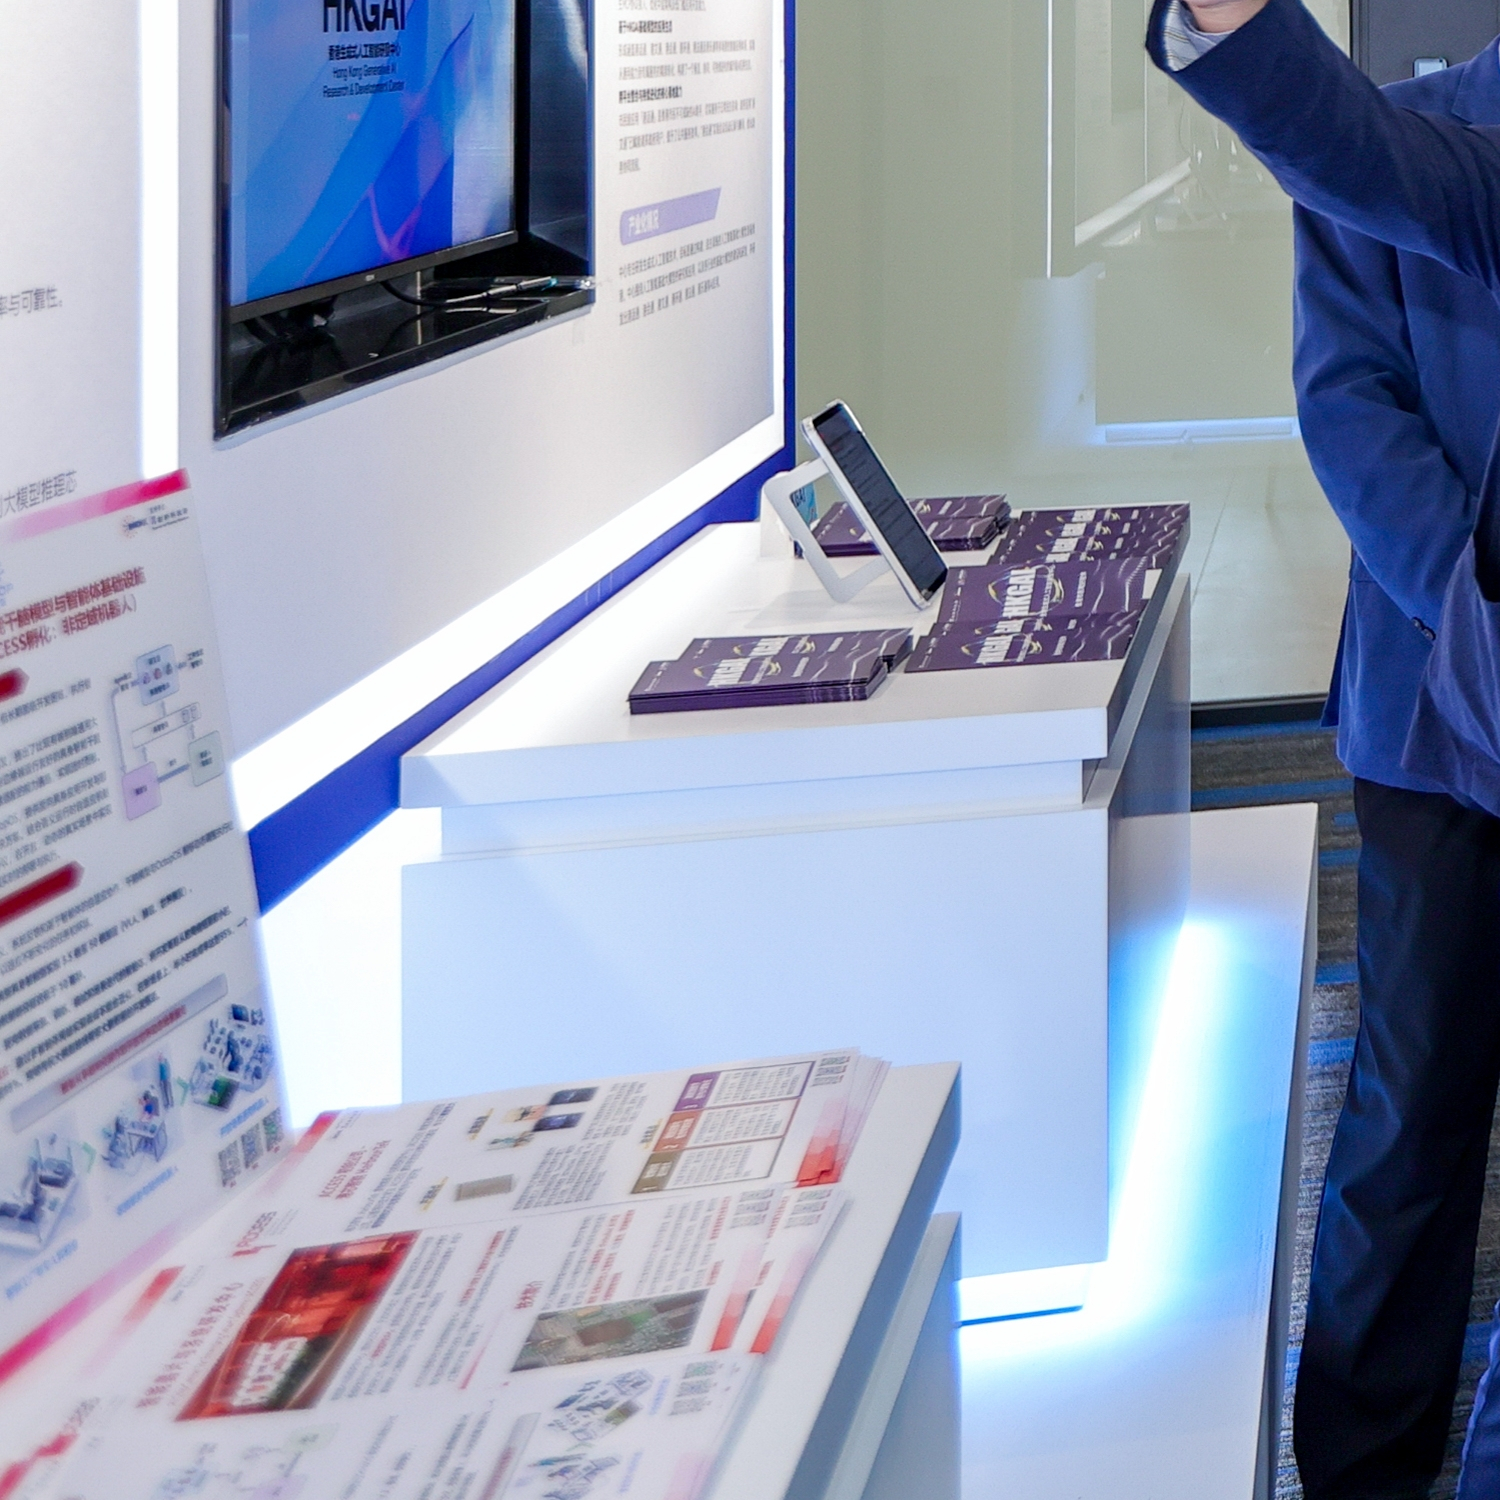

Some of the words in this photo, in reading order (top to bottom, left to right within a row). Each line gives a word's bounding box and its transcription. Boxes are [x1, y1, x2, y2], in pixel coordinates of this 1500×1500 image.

[0, 471, 77, 518] 大模型推理芯
